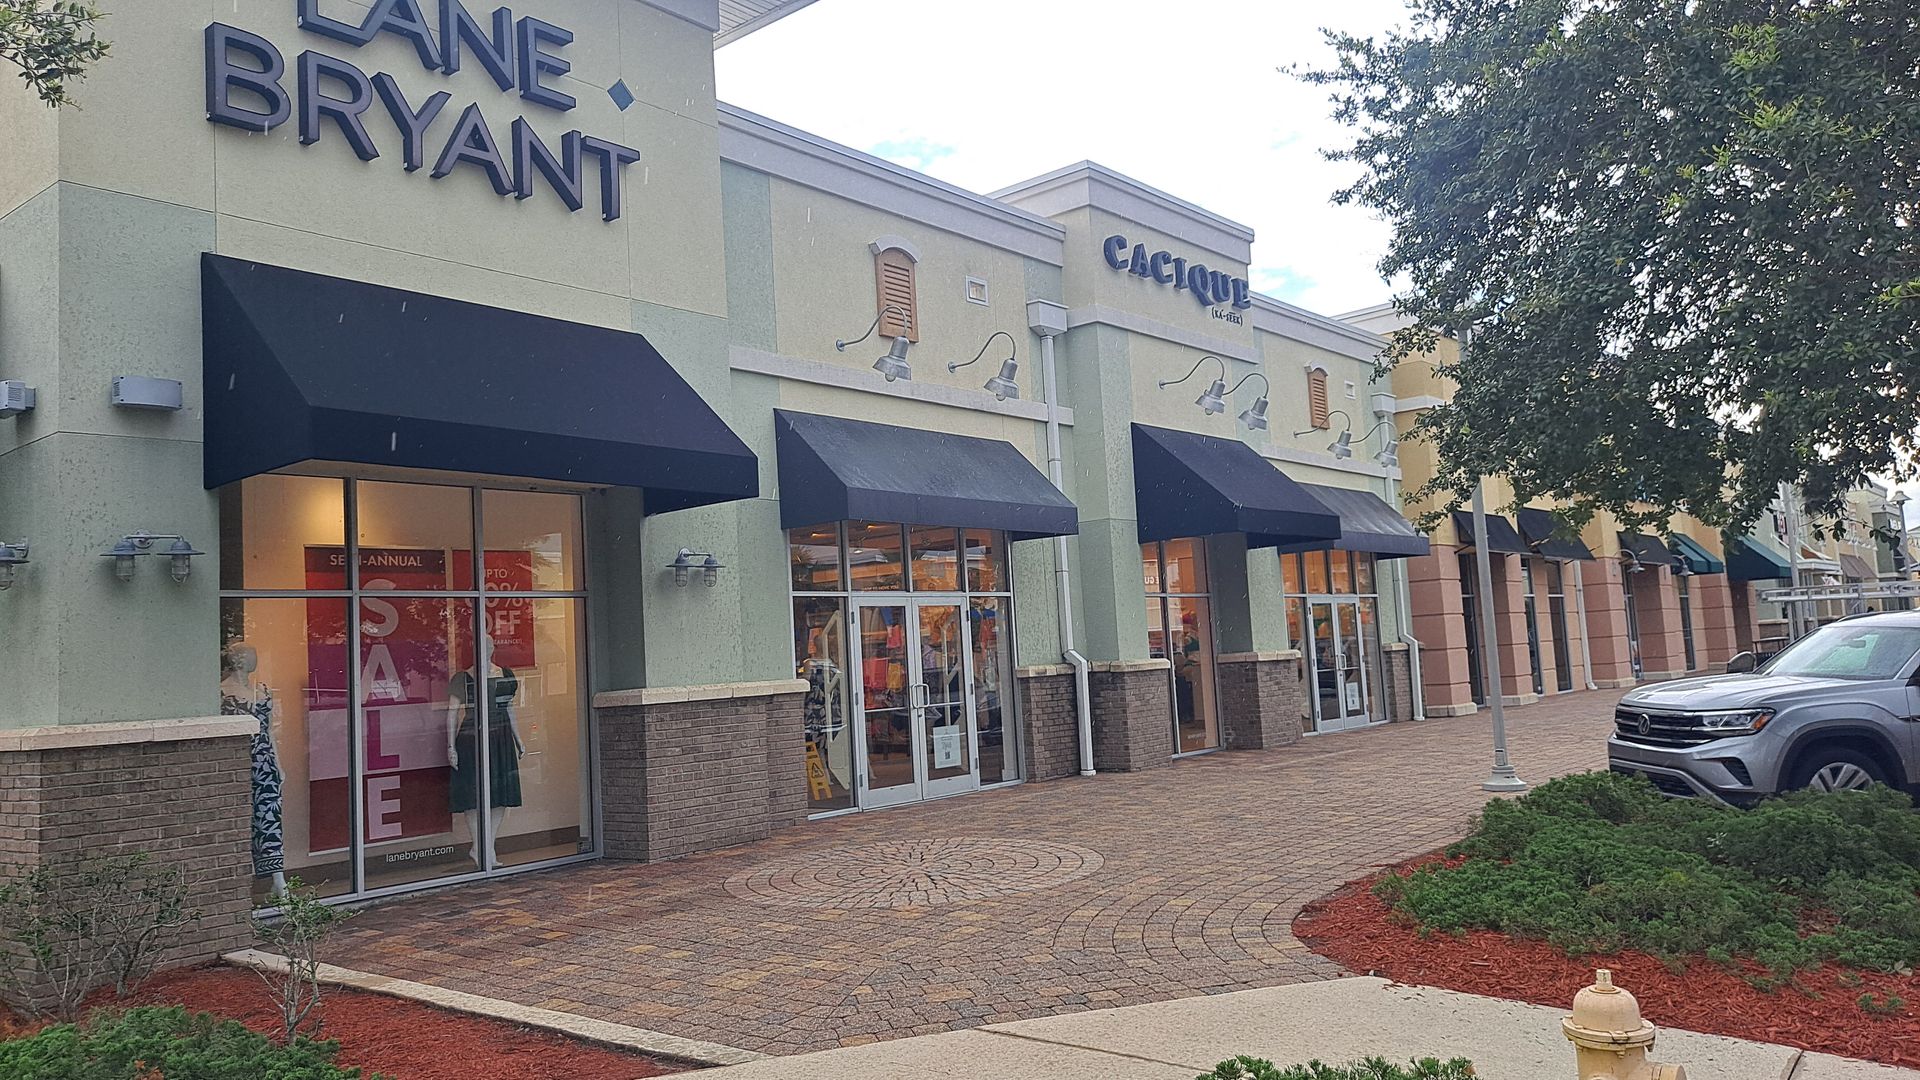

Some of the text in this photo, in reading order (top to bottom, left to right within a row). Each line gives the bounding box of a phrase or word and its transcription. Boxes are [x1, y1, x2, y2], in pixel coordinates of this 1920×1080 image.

[205, 21, 641, 223] BRYANT
[1103, 234, 1252, 310] CACIQUE
[330, 553, 423, 567] SEI-ANNUAL
[361, 578, 403, 840] SALE
[386, 846, 454, 863] lanebryant.com
